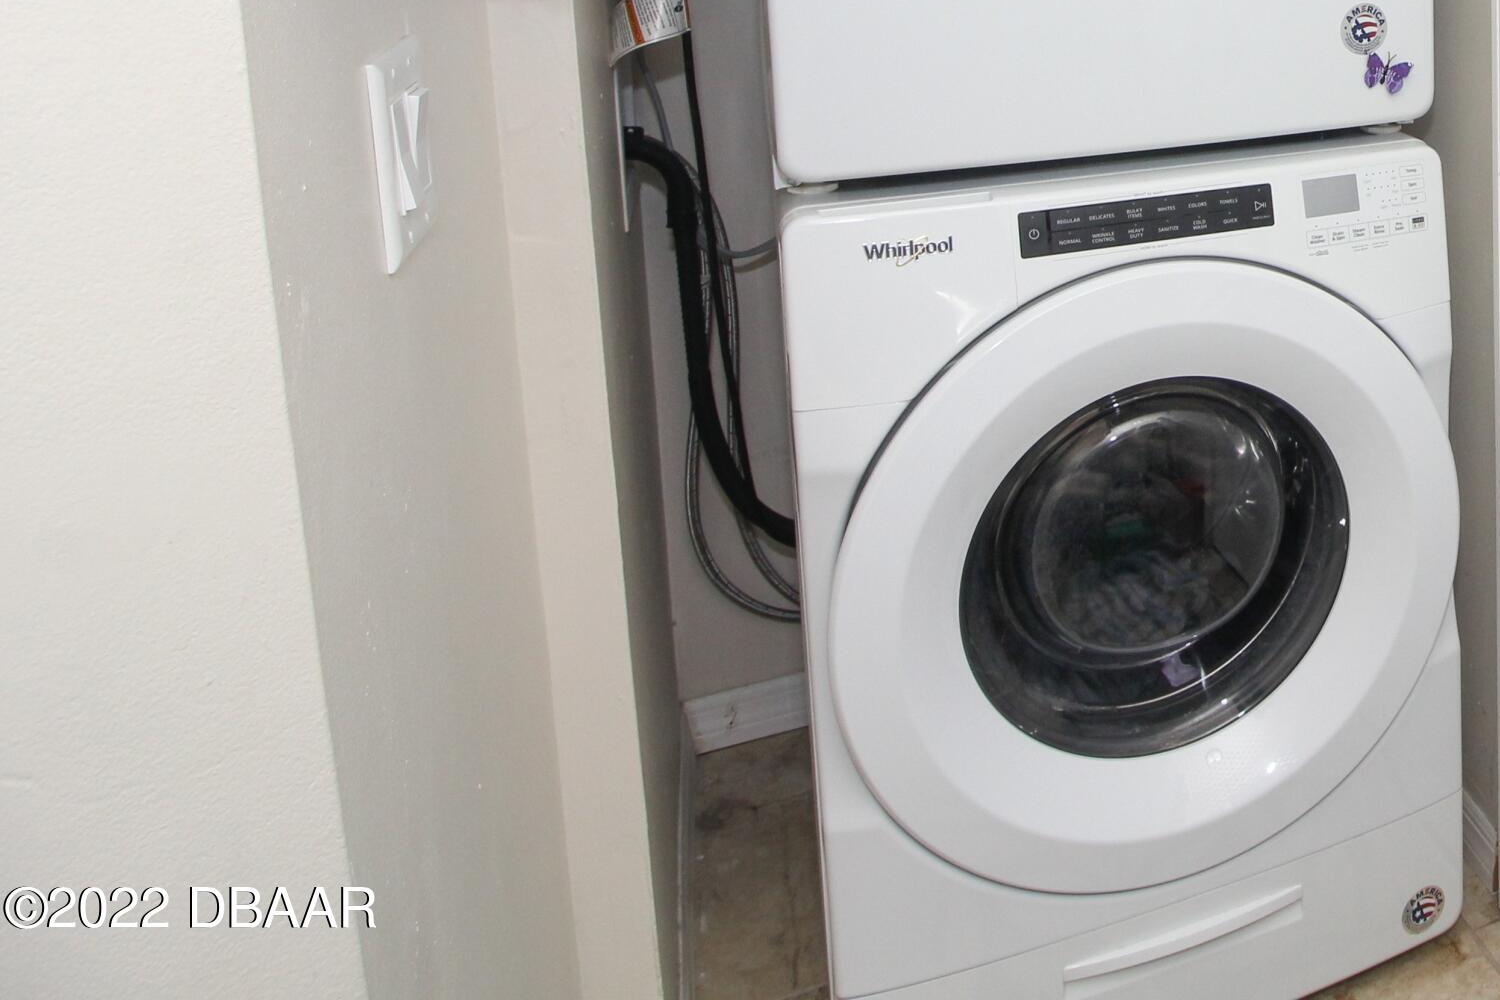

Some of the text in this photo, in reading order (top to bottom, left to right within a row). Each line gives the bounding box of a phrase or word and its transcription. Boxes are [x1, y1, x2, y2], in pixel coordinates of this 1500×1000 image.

[1346, 5, 1385, 26] AMERICA
[1188, 201, 1208, 209] COLORS
[1056, 217, 1081, 225] REGULAR
[1088, 213, 1116, 221] DELICATES
[1222, 217, 1239, 225] QUICK
[1157, 225, 1180, 233] SANITIZE
[1058, 238, 1082, 246] NORMAL
[863, 235, 953, 262] Whirlpool
[1409, 887, 1443, 906] AMERICA
